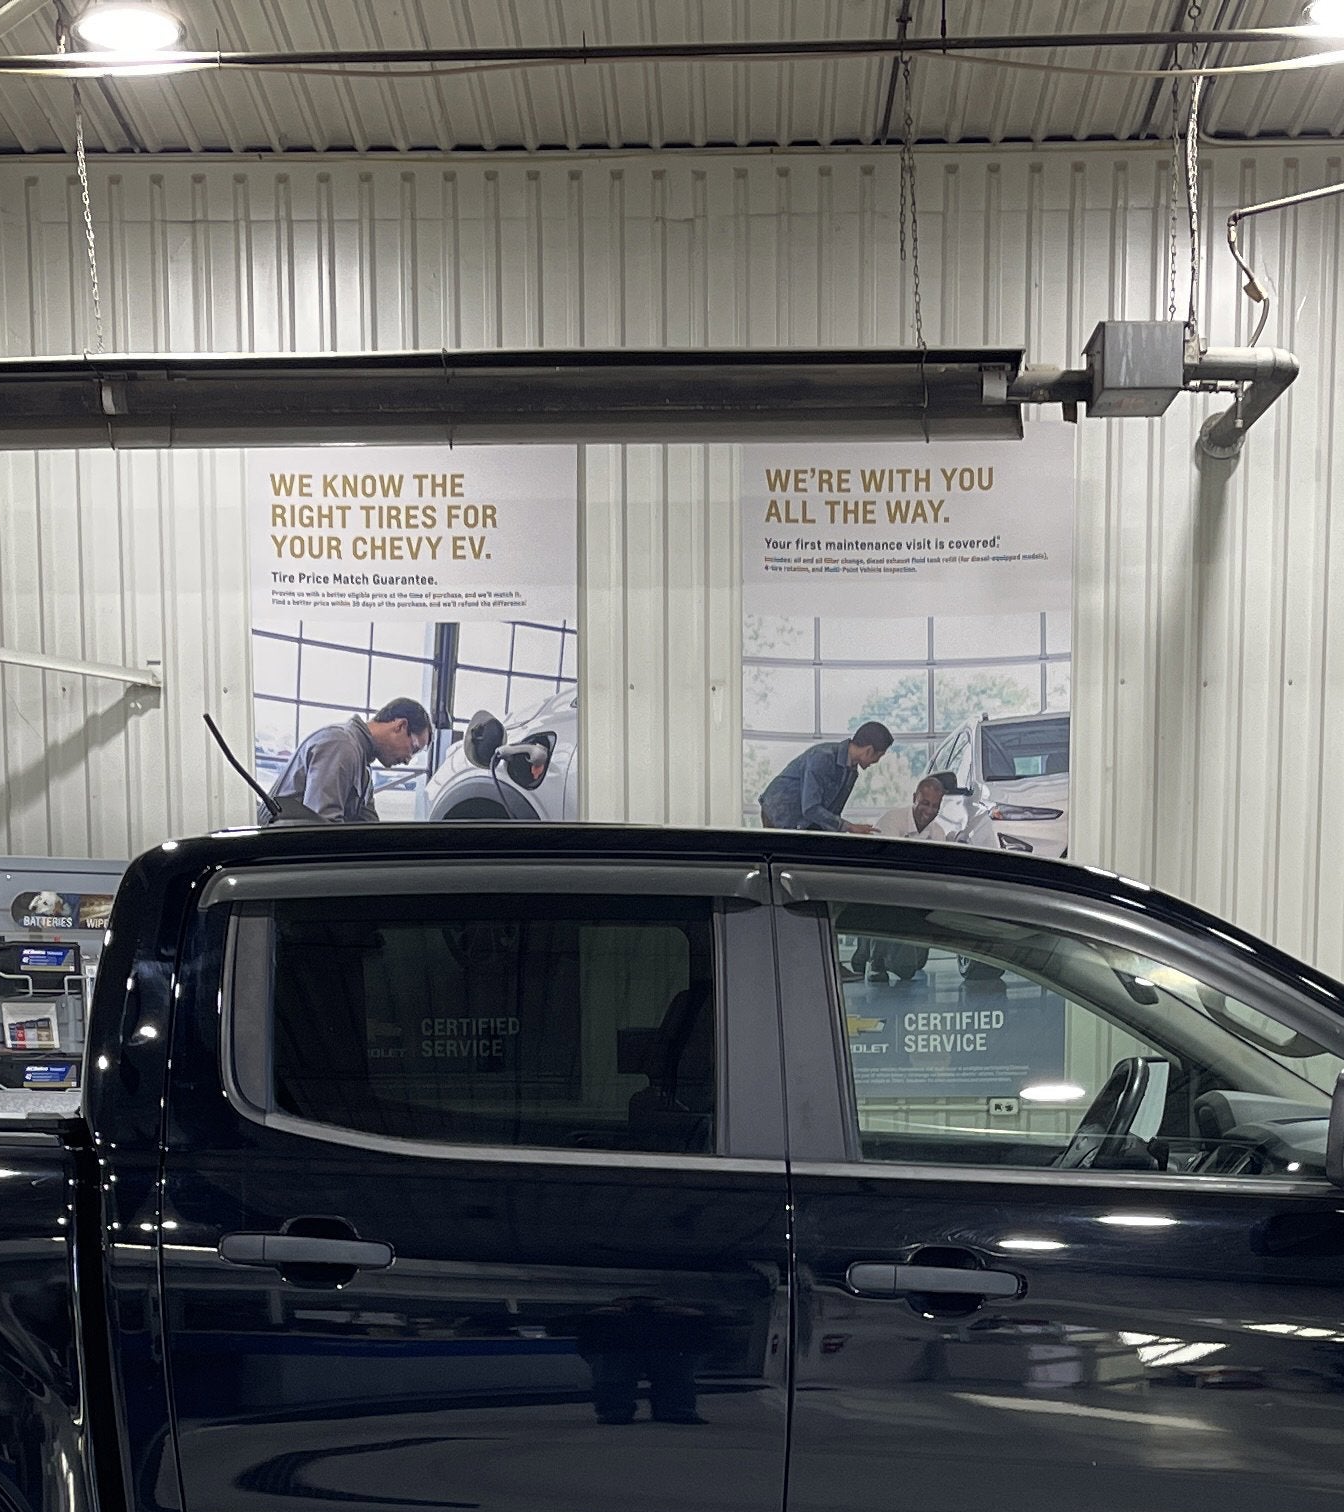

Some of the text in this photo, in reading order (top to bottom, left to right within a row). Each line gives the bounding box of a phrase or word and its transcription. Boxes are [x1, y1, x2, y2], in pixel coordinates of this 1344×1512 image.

[270, 474, 464, 498] WE KNOW THE
[766, 466, 994, 493] WE'RE WITH YOU
[271, 504, 497, 529] RIGHT TIRES FOR
[765, 499, 950, 524] ALL THE WAY.
[271, 535, 491, 560] YOUR CHEVY EV.
[765, 538, 792, 550] Your
[796, 538, 822, 550] first
[826, 539, 902, 550] maintenance
[906, 538, 931, 550] visit
[936, 538, 944, 550] is
[272, 572, 438, 586] Tire Price Match Guarantee.
[24, 916, 72, 928] BATTERIES
[421, 1017, 520, 1036] CERTIFIED
[904, 1010, 1004, 1031] CERTIFIED
[421, 1040, 503, 1058] SERVICE
[904, 1033, 988, 1053] SERVICE
